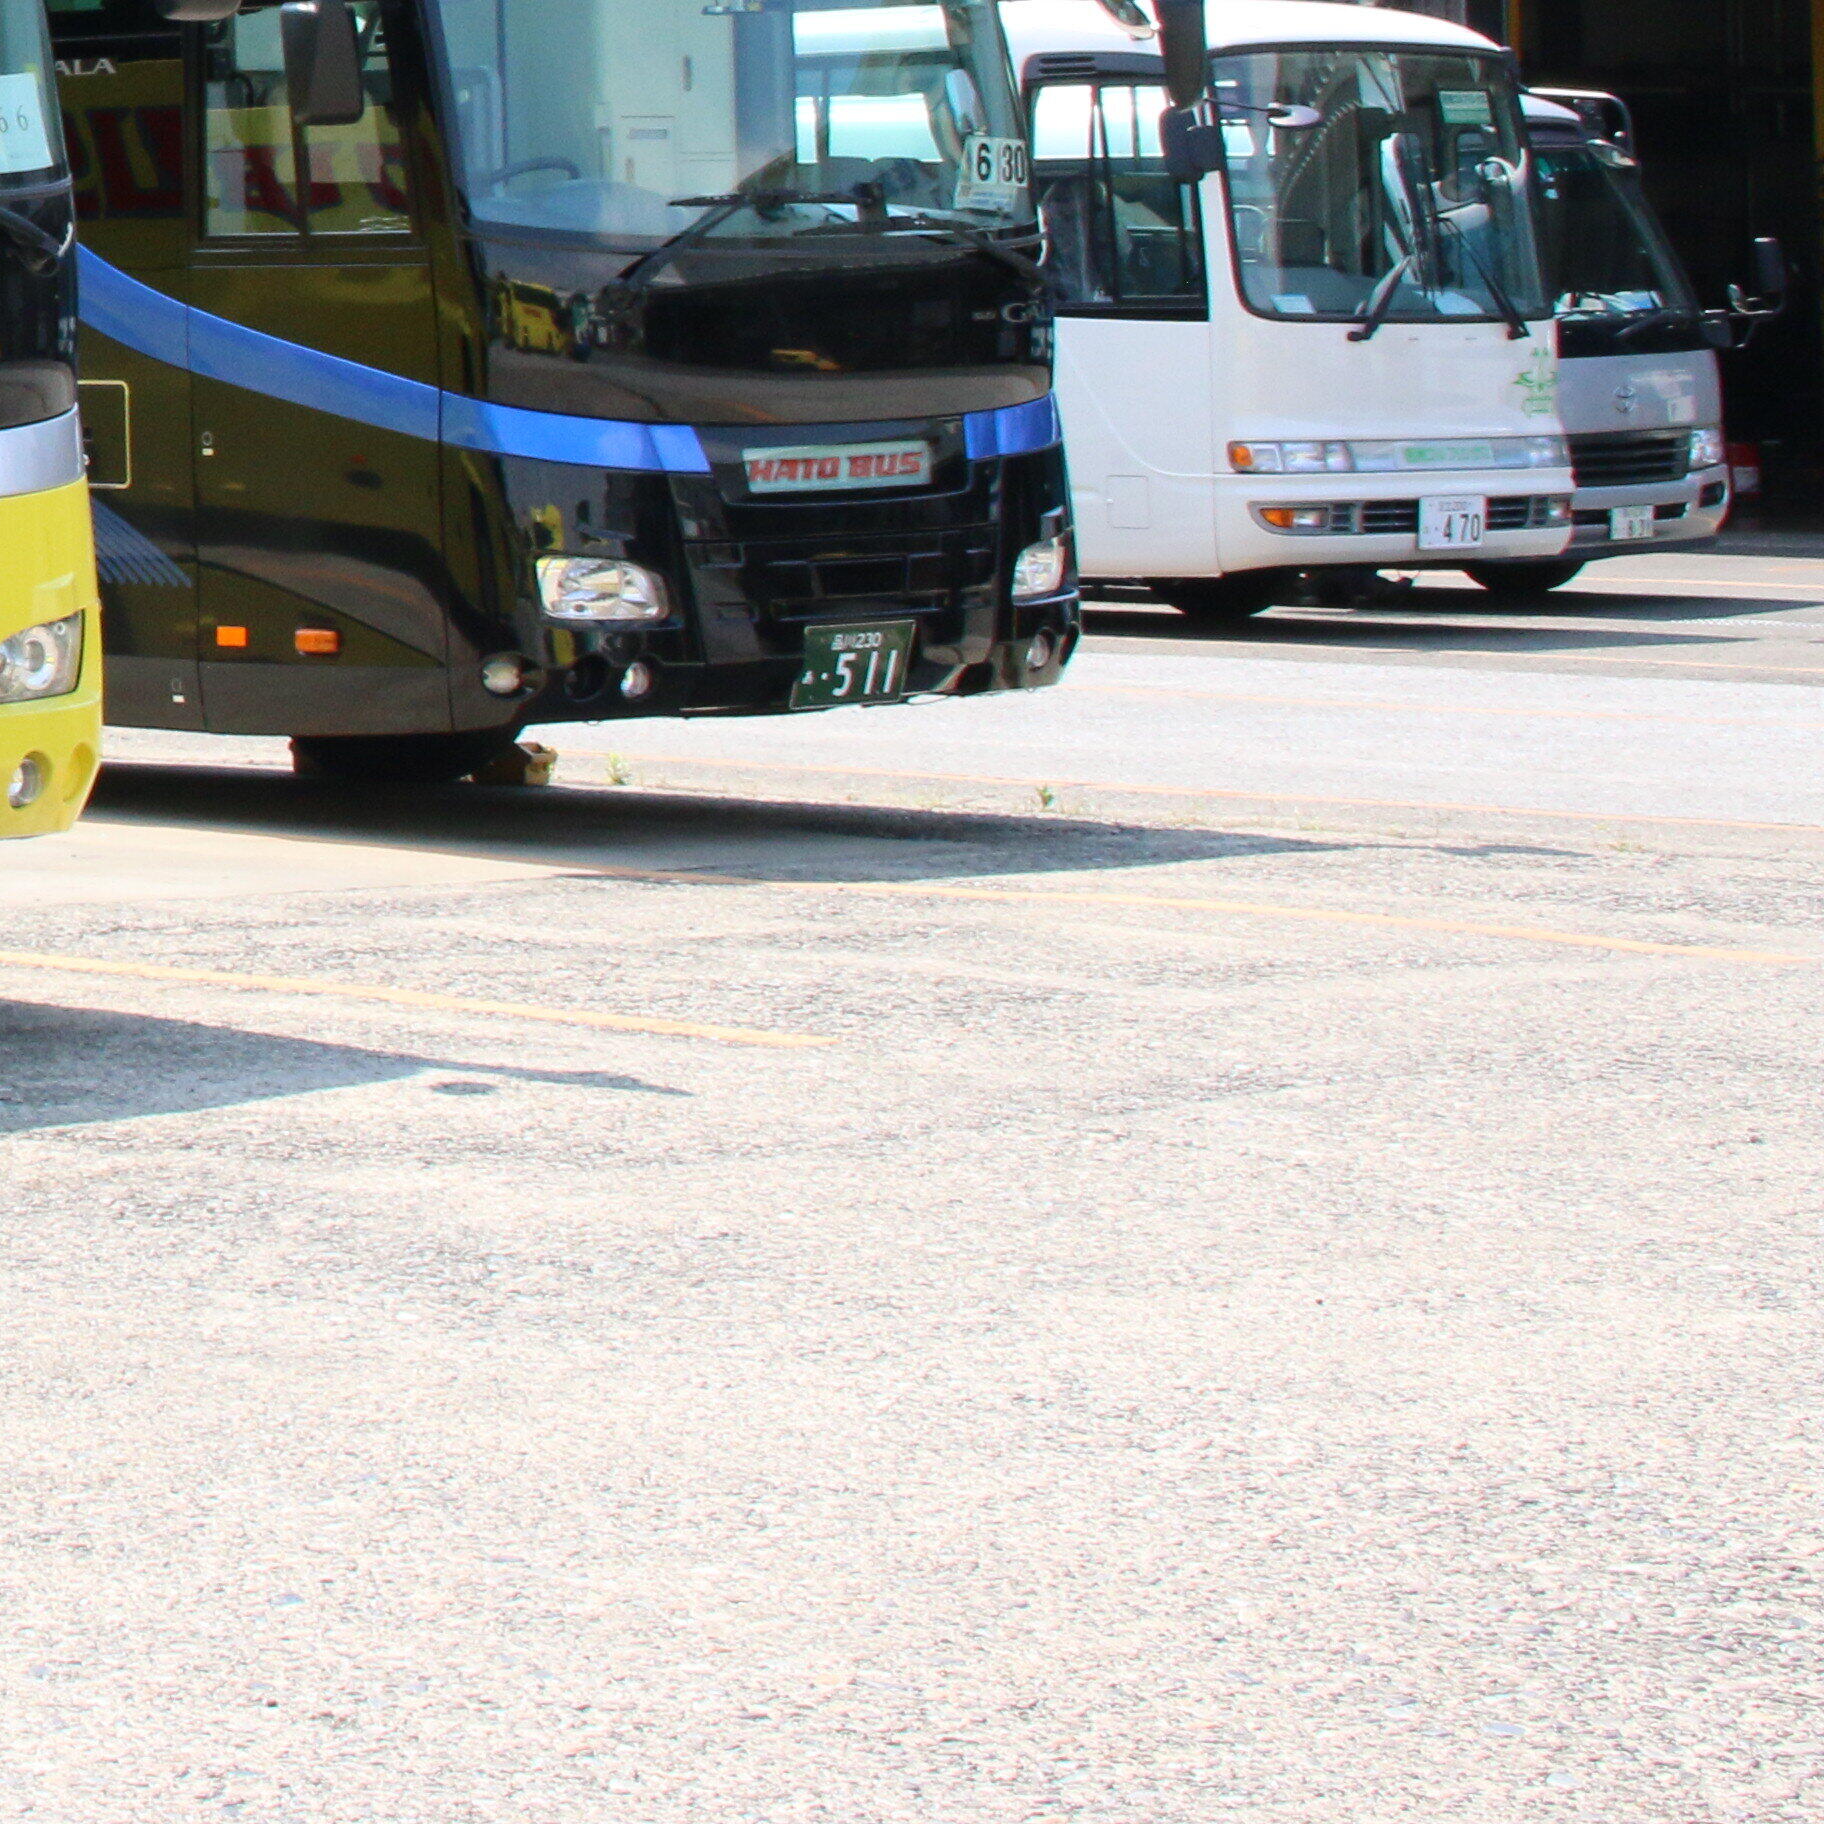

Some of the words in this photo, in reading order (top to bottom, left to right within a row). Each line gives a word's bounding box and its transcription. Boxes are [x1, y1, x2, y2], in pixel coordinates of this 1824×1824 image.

[977, 143, 991, 182] 6
[1002, 144, 1026, 184] 30
[748, 457, 840, 482] HATO
[848, 451, 924, 477] BUS
